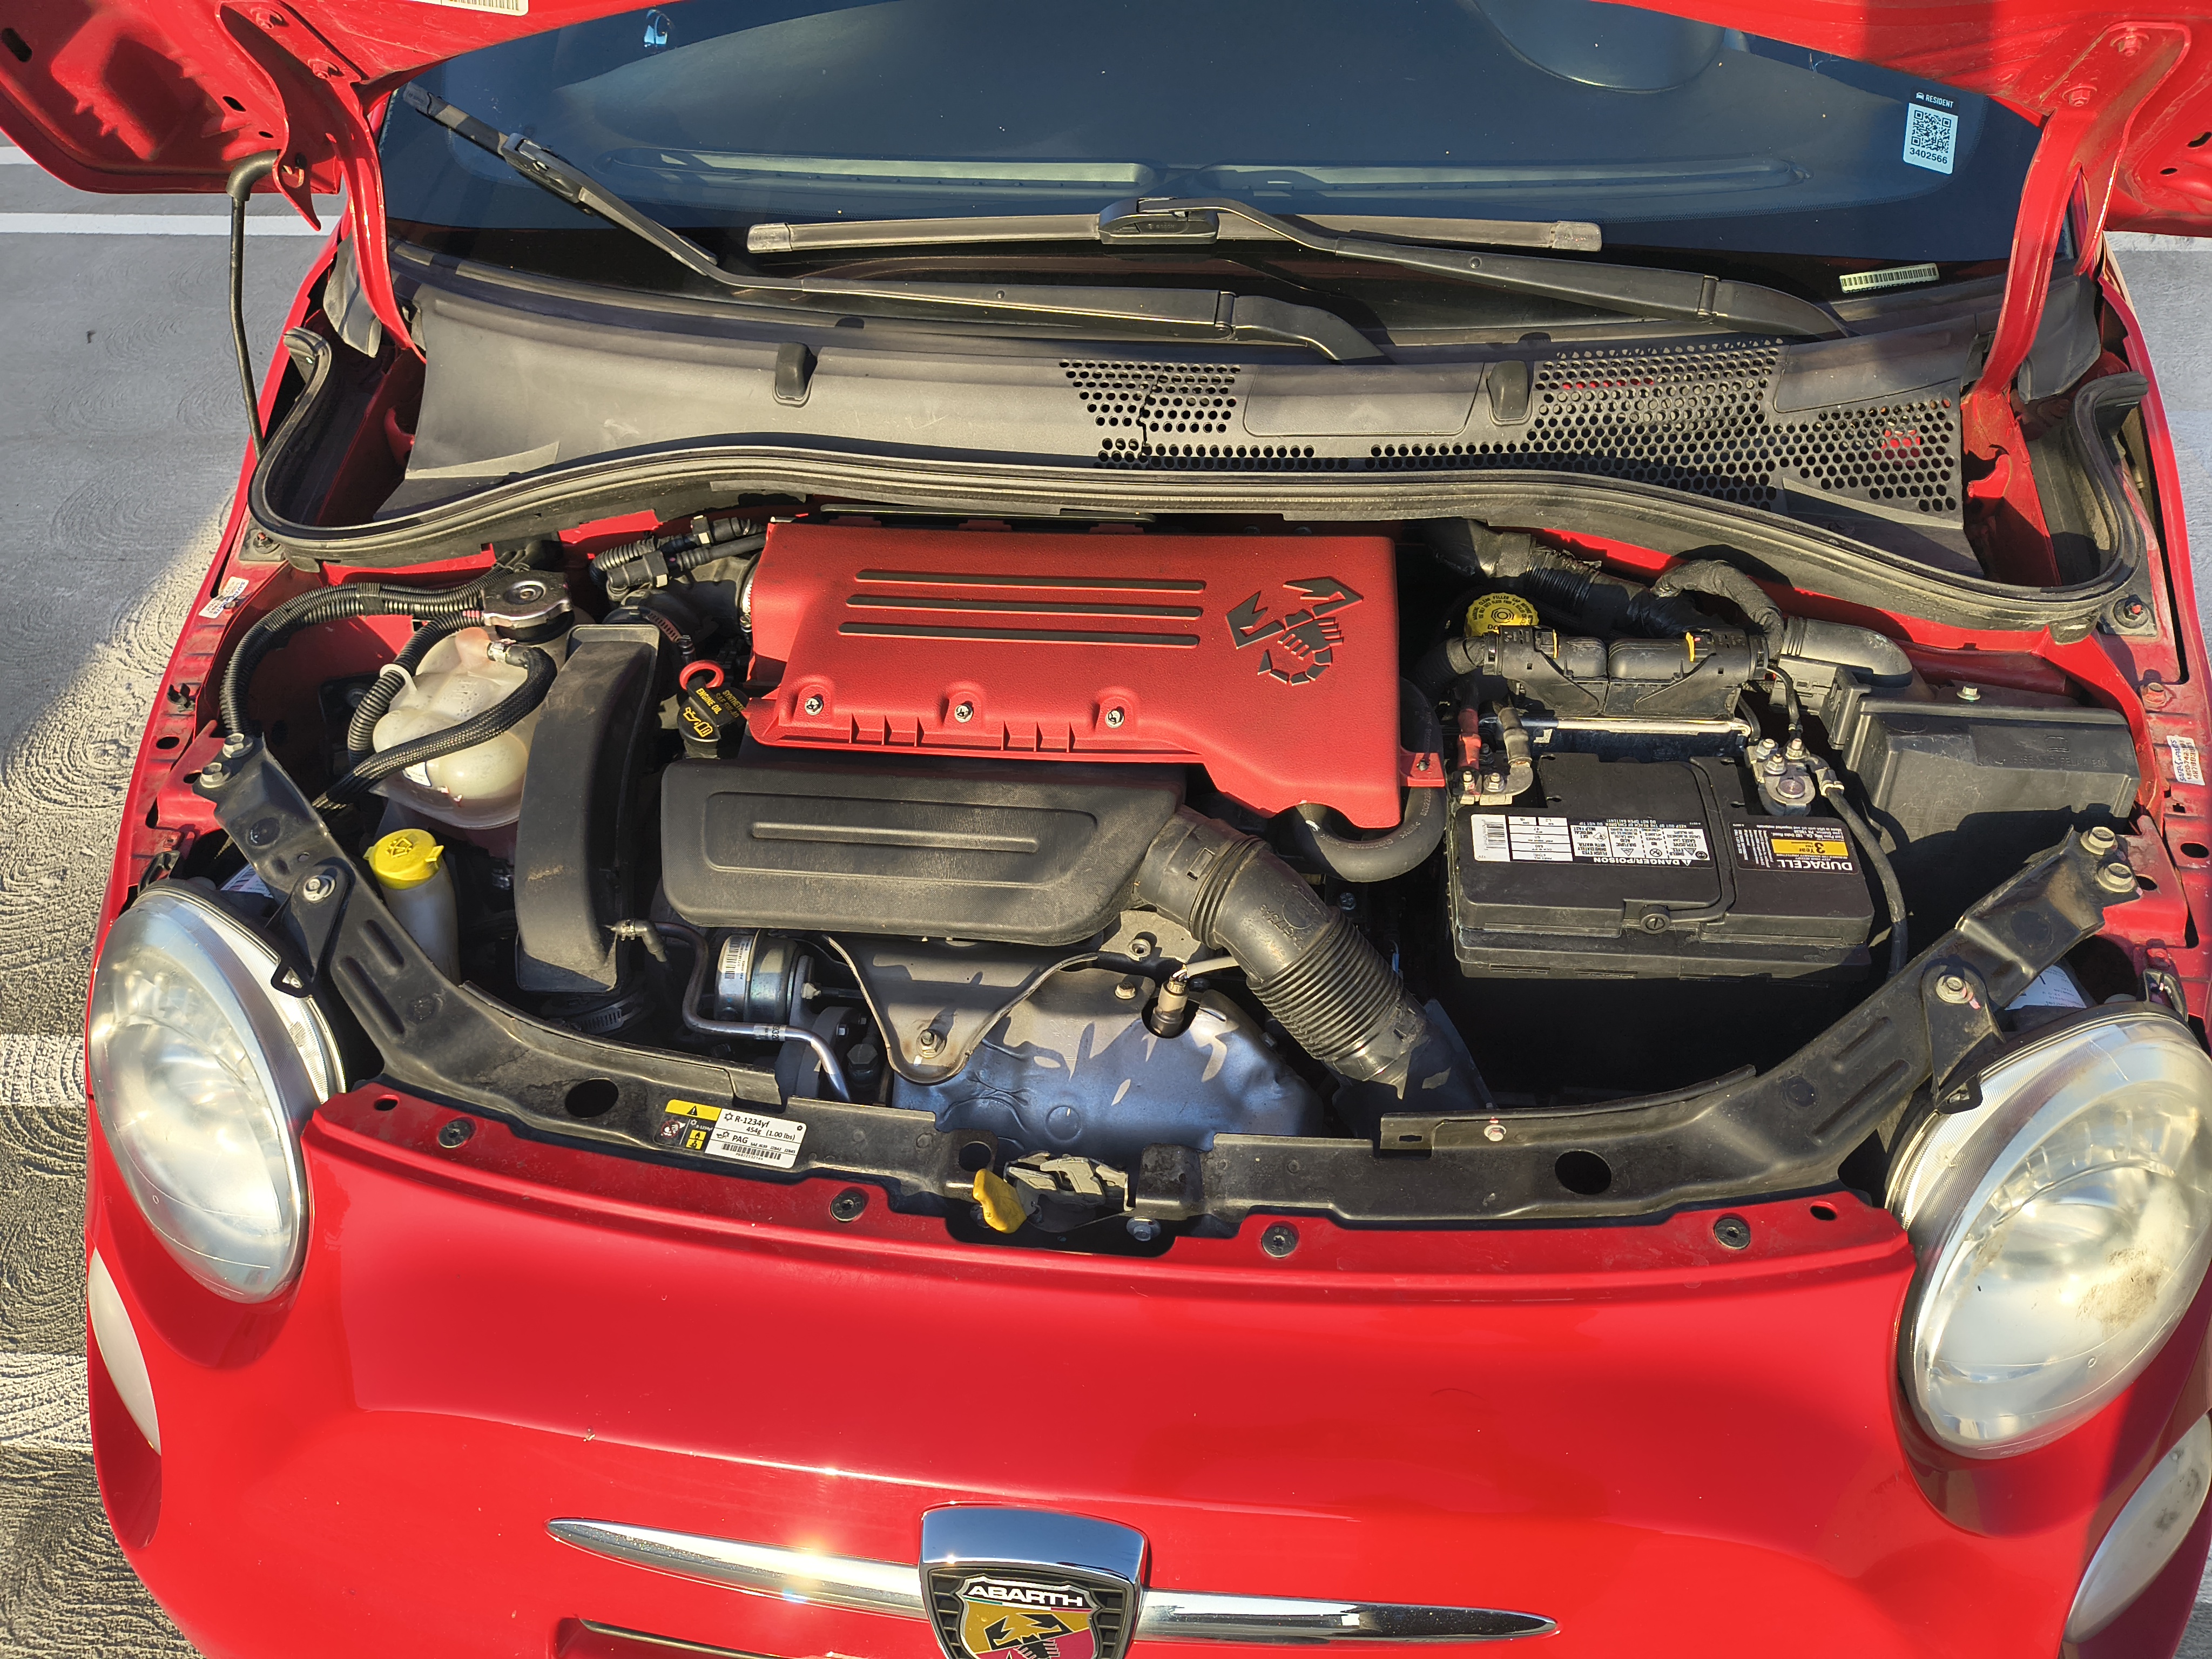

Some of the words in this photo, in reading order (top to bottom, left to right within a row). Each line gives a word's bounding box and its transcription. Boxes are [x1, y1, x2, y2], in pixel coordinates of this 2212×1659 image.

[1926, 94, 1953, 108] RESIDENT
[1910, 148, 1947, 164] 3402566
[696, 688, 715, 706] ENGINE
[711, 704, 723, 714] OIL
[723, 690, 746, 712] SYNTHETIC
[1815, 842, 1825, 853] 3
[1594, 857, 1680, 865] DANGER/POISON
[1777, 859, 1852, 870] DURACELL
[734, 1116, 770, 1129] R-1234yf
[732, 1135, 748, 1144] PAG
[746, 1126, 762, 1135] 454g
[766, 1129, 781, 1138] (1.00
[783, 1132, 795, 1141] lbs)
[968, 1586, 1083, 1607] ABARTH
